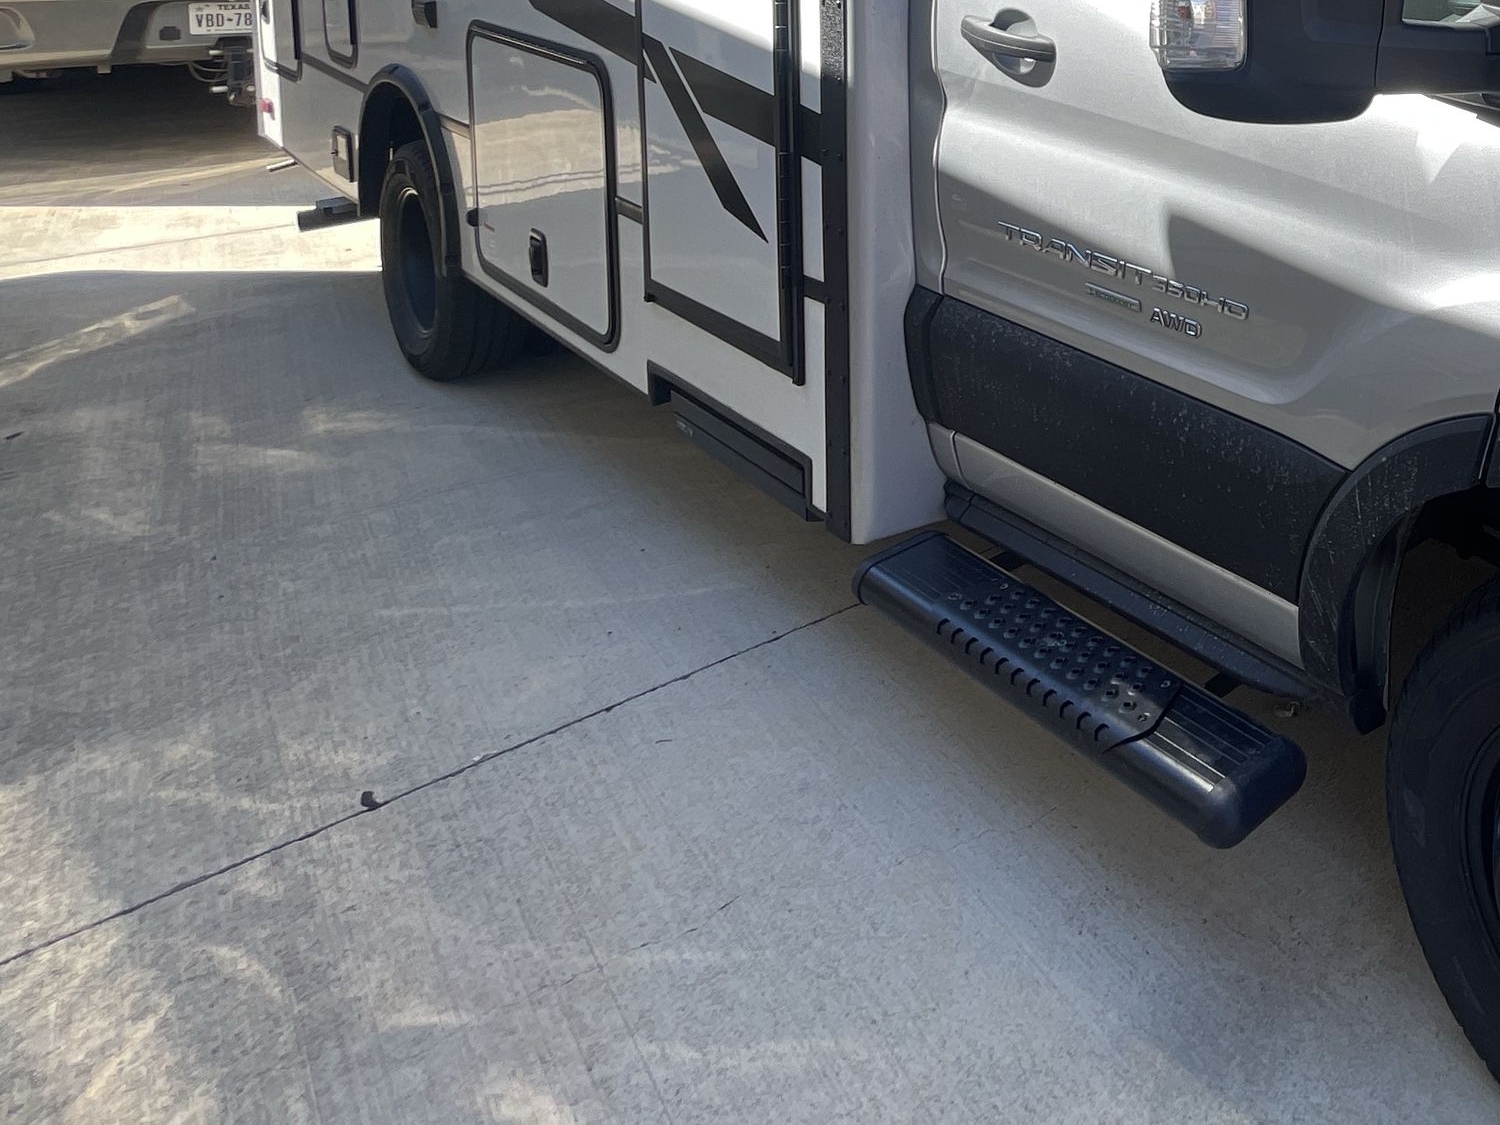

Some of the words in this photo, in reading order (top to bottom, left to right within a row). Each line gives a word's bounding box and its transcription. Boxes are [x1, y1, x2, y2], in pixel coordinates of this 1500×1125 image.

[217, 3, 250, 11] TEXAS
[997, 220, 1152, 285] TRANSIT
[1151, 274, 1249, 321] 350HD
[1150, 306, 1203, 339] AWD
